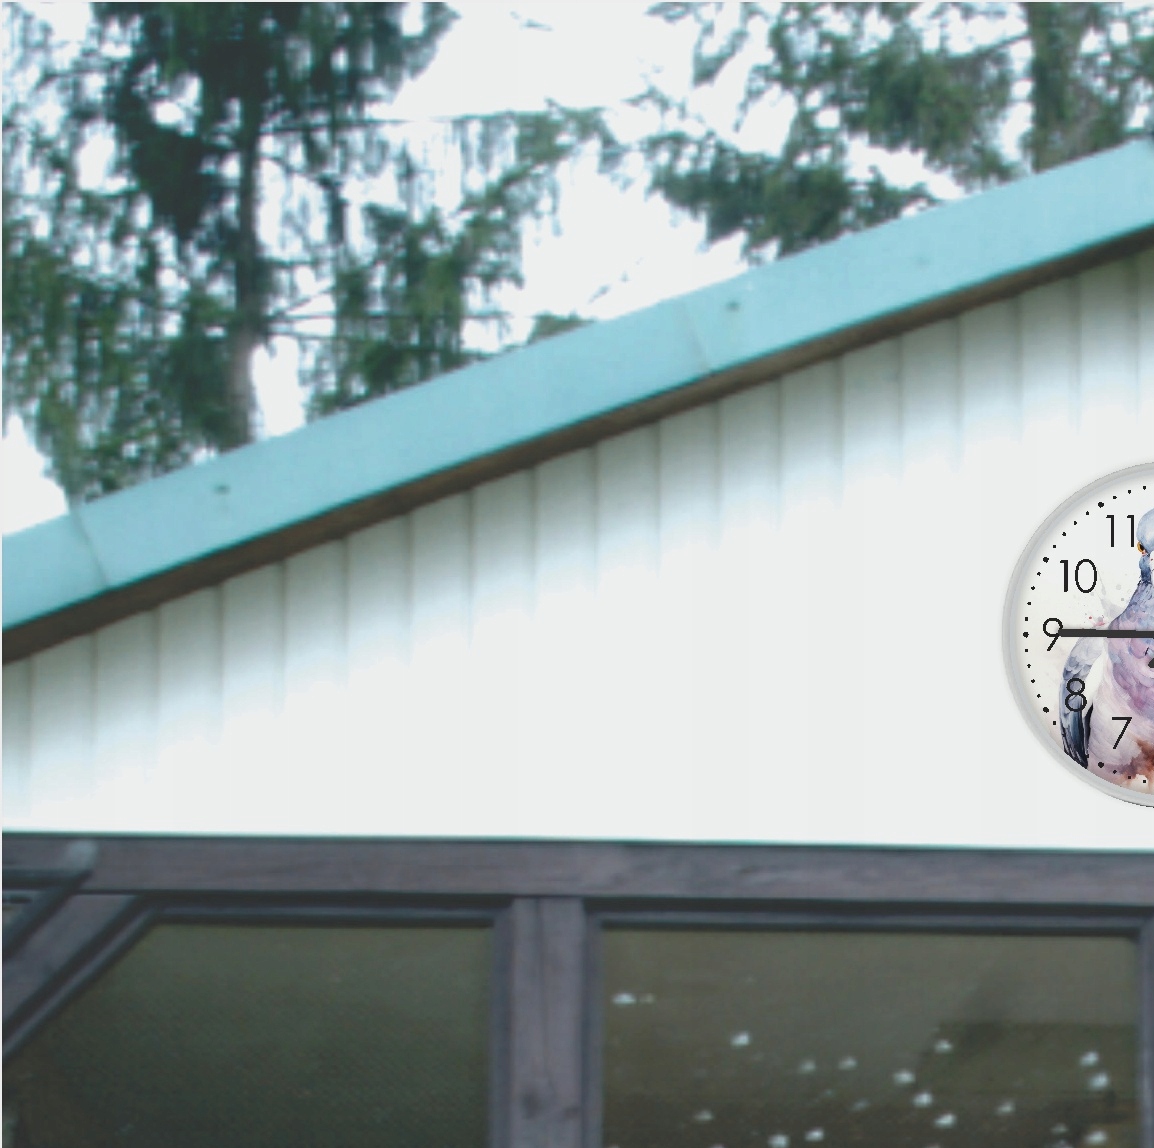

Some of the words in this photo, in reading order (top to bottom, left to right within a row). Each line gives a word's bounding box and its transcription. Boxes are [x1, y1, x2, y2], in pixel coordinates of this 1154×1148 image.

[1105, 514, 1135, 548] 11
[1059, 558, 1098, 593] 10
[1042, 617, 1064, 652] 9
[1064, 677, 1088, 712] 8
[1111, 716, 1133, 750] 7
